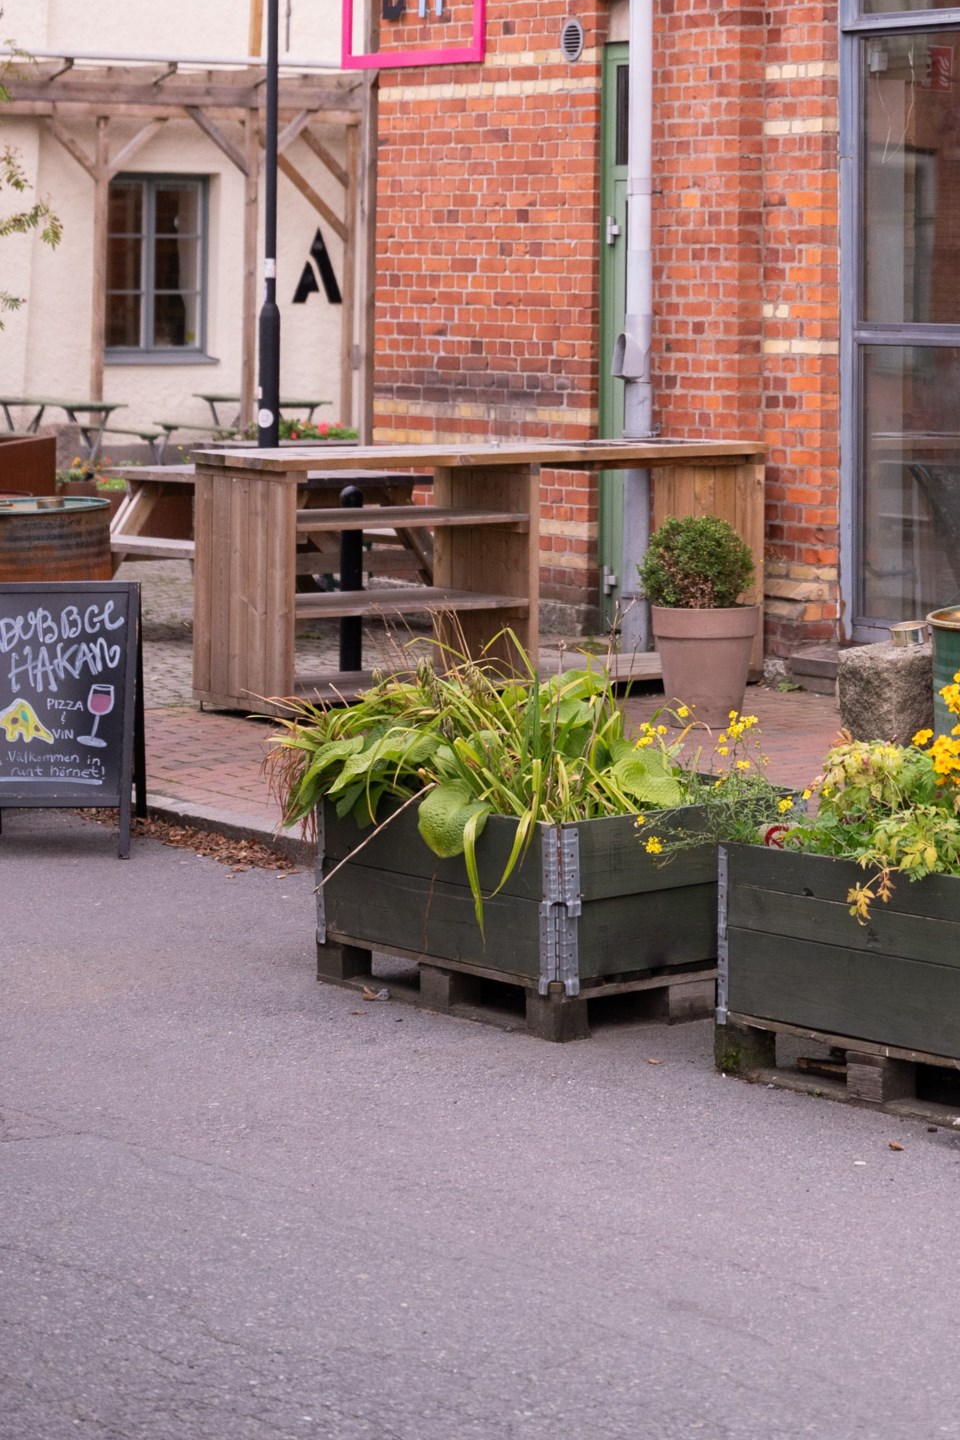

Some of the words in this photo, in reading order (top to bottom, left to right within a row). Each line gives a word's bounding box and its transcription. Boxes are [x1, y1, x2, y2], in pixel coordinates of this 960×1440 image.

[8, 637, 121, 693] HAKAN
[47, 698, 84, 712] PIZZA
[52, 728, 74, 740] VIN
[8, 750, 80, 764] Välkommen
[87, 755, 101, 766] in
[10, 766, 44, 777] runt
[50, 766, 106, 780] hörnet!
